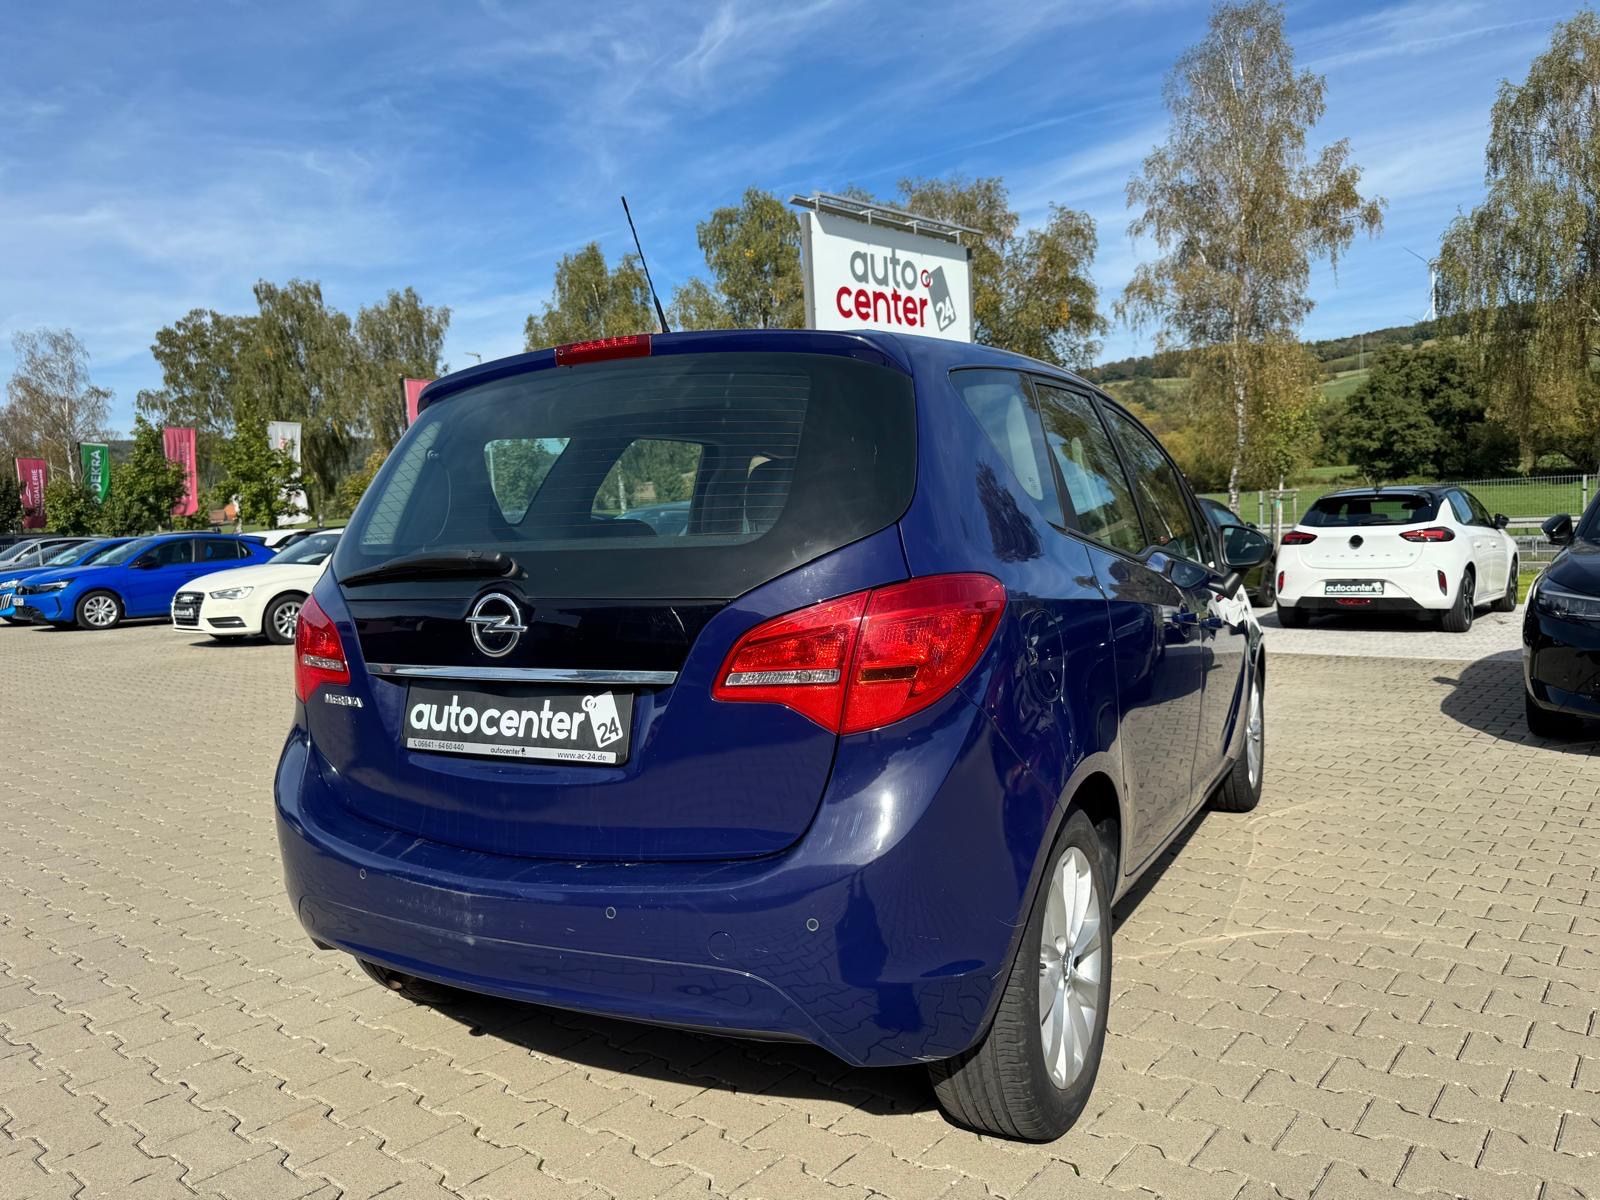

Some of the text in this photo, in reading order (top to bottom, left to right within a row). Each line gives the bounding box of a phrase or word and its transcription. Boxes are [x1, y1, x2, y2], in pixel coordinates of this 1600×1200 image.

[850, 248, 918, 290] auto
[836, 286, 928, 327] center
[936, 296, 954, 328] 24
[89, 449, 102, 492] DEKRA
[1325, 583, 1373, 592] autocenter
[409, 695, 585, 740] autocenter
[596, 717, 620, 744] 24
[490, 747, 520, 755] autocenter
[557, 751, 607, 761] www.ac-24.de
